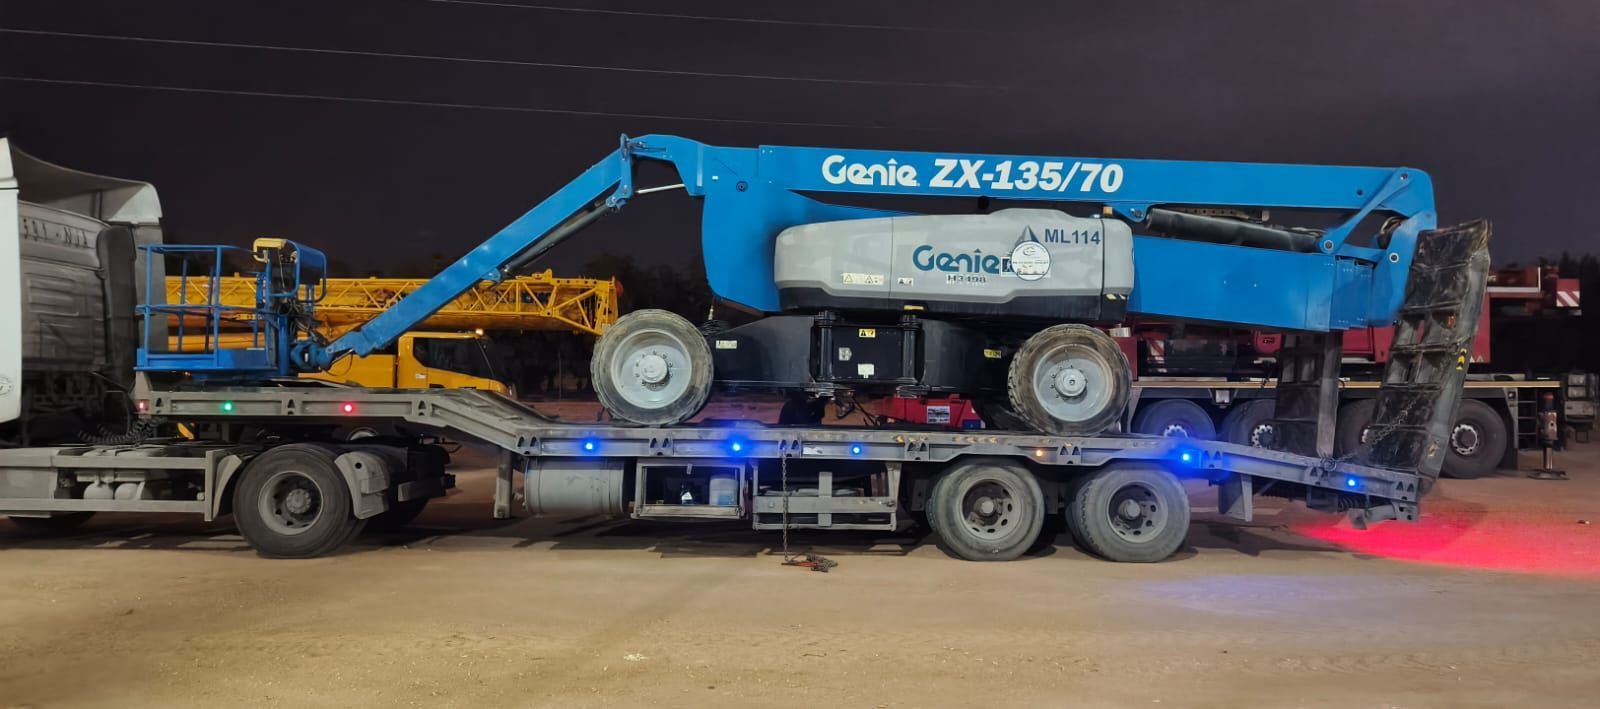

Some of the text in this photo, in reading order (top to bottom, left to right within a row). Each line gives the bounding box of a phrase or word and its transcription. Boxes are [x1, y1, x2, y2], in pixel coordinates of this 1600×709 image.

[822, 154, 1124, 193] Genie ZX-135/70
[1044, 228, 1101, 245] ML114
[912, 244, 1000, 274] Genie
